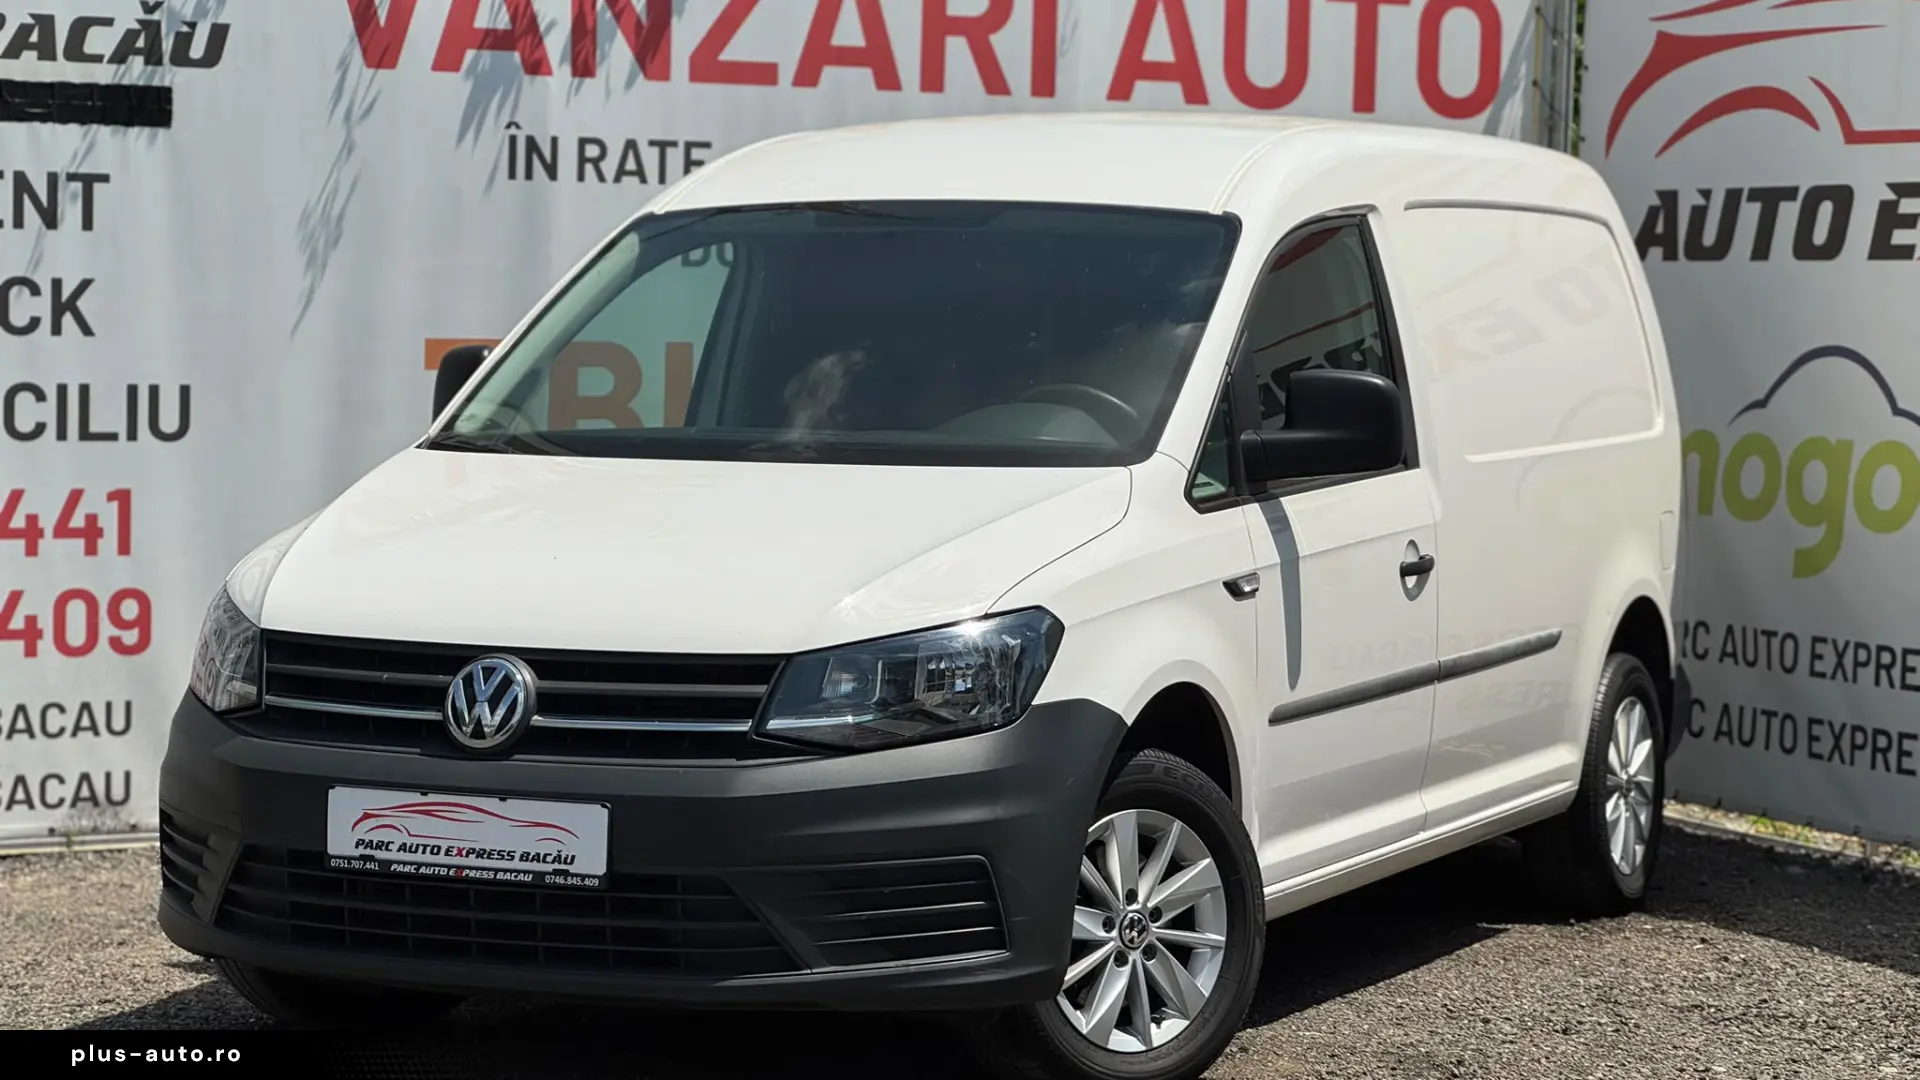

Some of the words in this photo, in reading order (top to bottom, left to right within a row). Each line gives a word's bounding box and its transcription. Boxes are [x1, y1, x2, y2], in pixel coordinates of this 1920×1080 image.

[0, 0, 230, 68] ACĂU
[1107, 0, 1504, 120] AUTO
[504, 121, 558, 181] ÎN
[0, 170, 110, 231] NT
[1636, 185, 1854, 262] AUTO
[1867, 182, 1920, 260] E
[0, 276, 95, 337] CK
[3, 382, 191, 442] CILIU
[0, 488, 131, 557] 441
[0, 587, 151, 658] 409
[1718, 624, 1799, 675] AUTO
[1809, 635, 1920, 692] EXPRE
[0, 700, 131, 740] ACAU
[1713, 703, 1798, 755] AUTO
[1807, 716, 1919, 777] EXPRE
[0, 770, 131, 811] ACAU
[330, 858, 379, 870] 0751.707.441
[354, 838, 395, 852] PARC
[396, 842, 442, 856] AUTO
[444, 845, 516, 862] EXPRESS
[518, 849, 576, 866] BACĂU
[390, 863, 418, 873] PARC
[419, 866, 448, 876] AUTO
[448, 868, 495, 880] EXPRESS
[496, 871, 533, 882] BACAU
[545, 875, 599, 886] 0746.845.409
